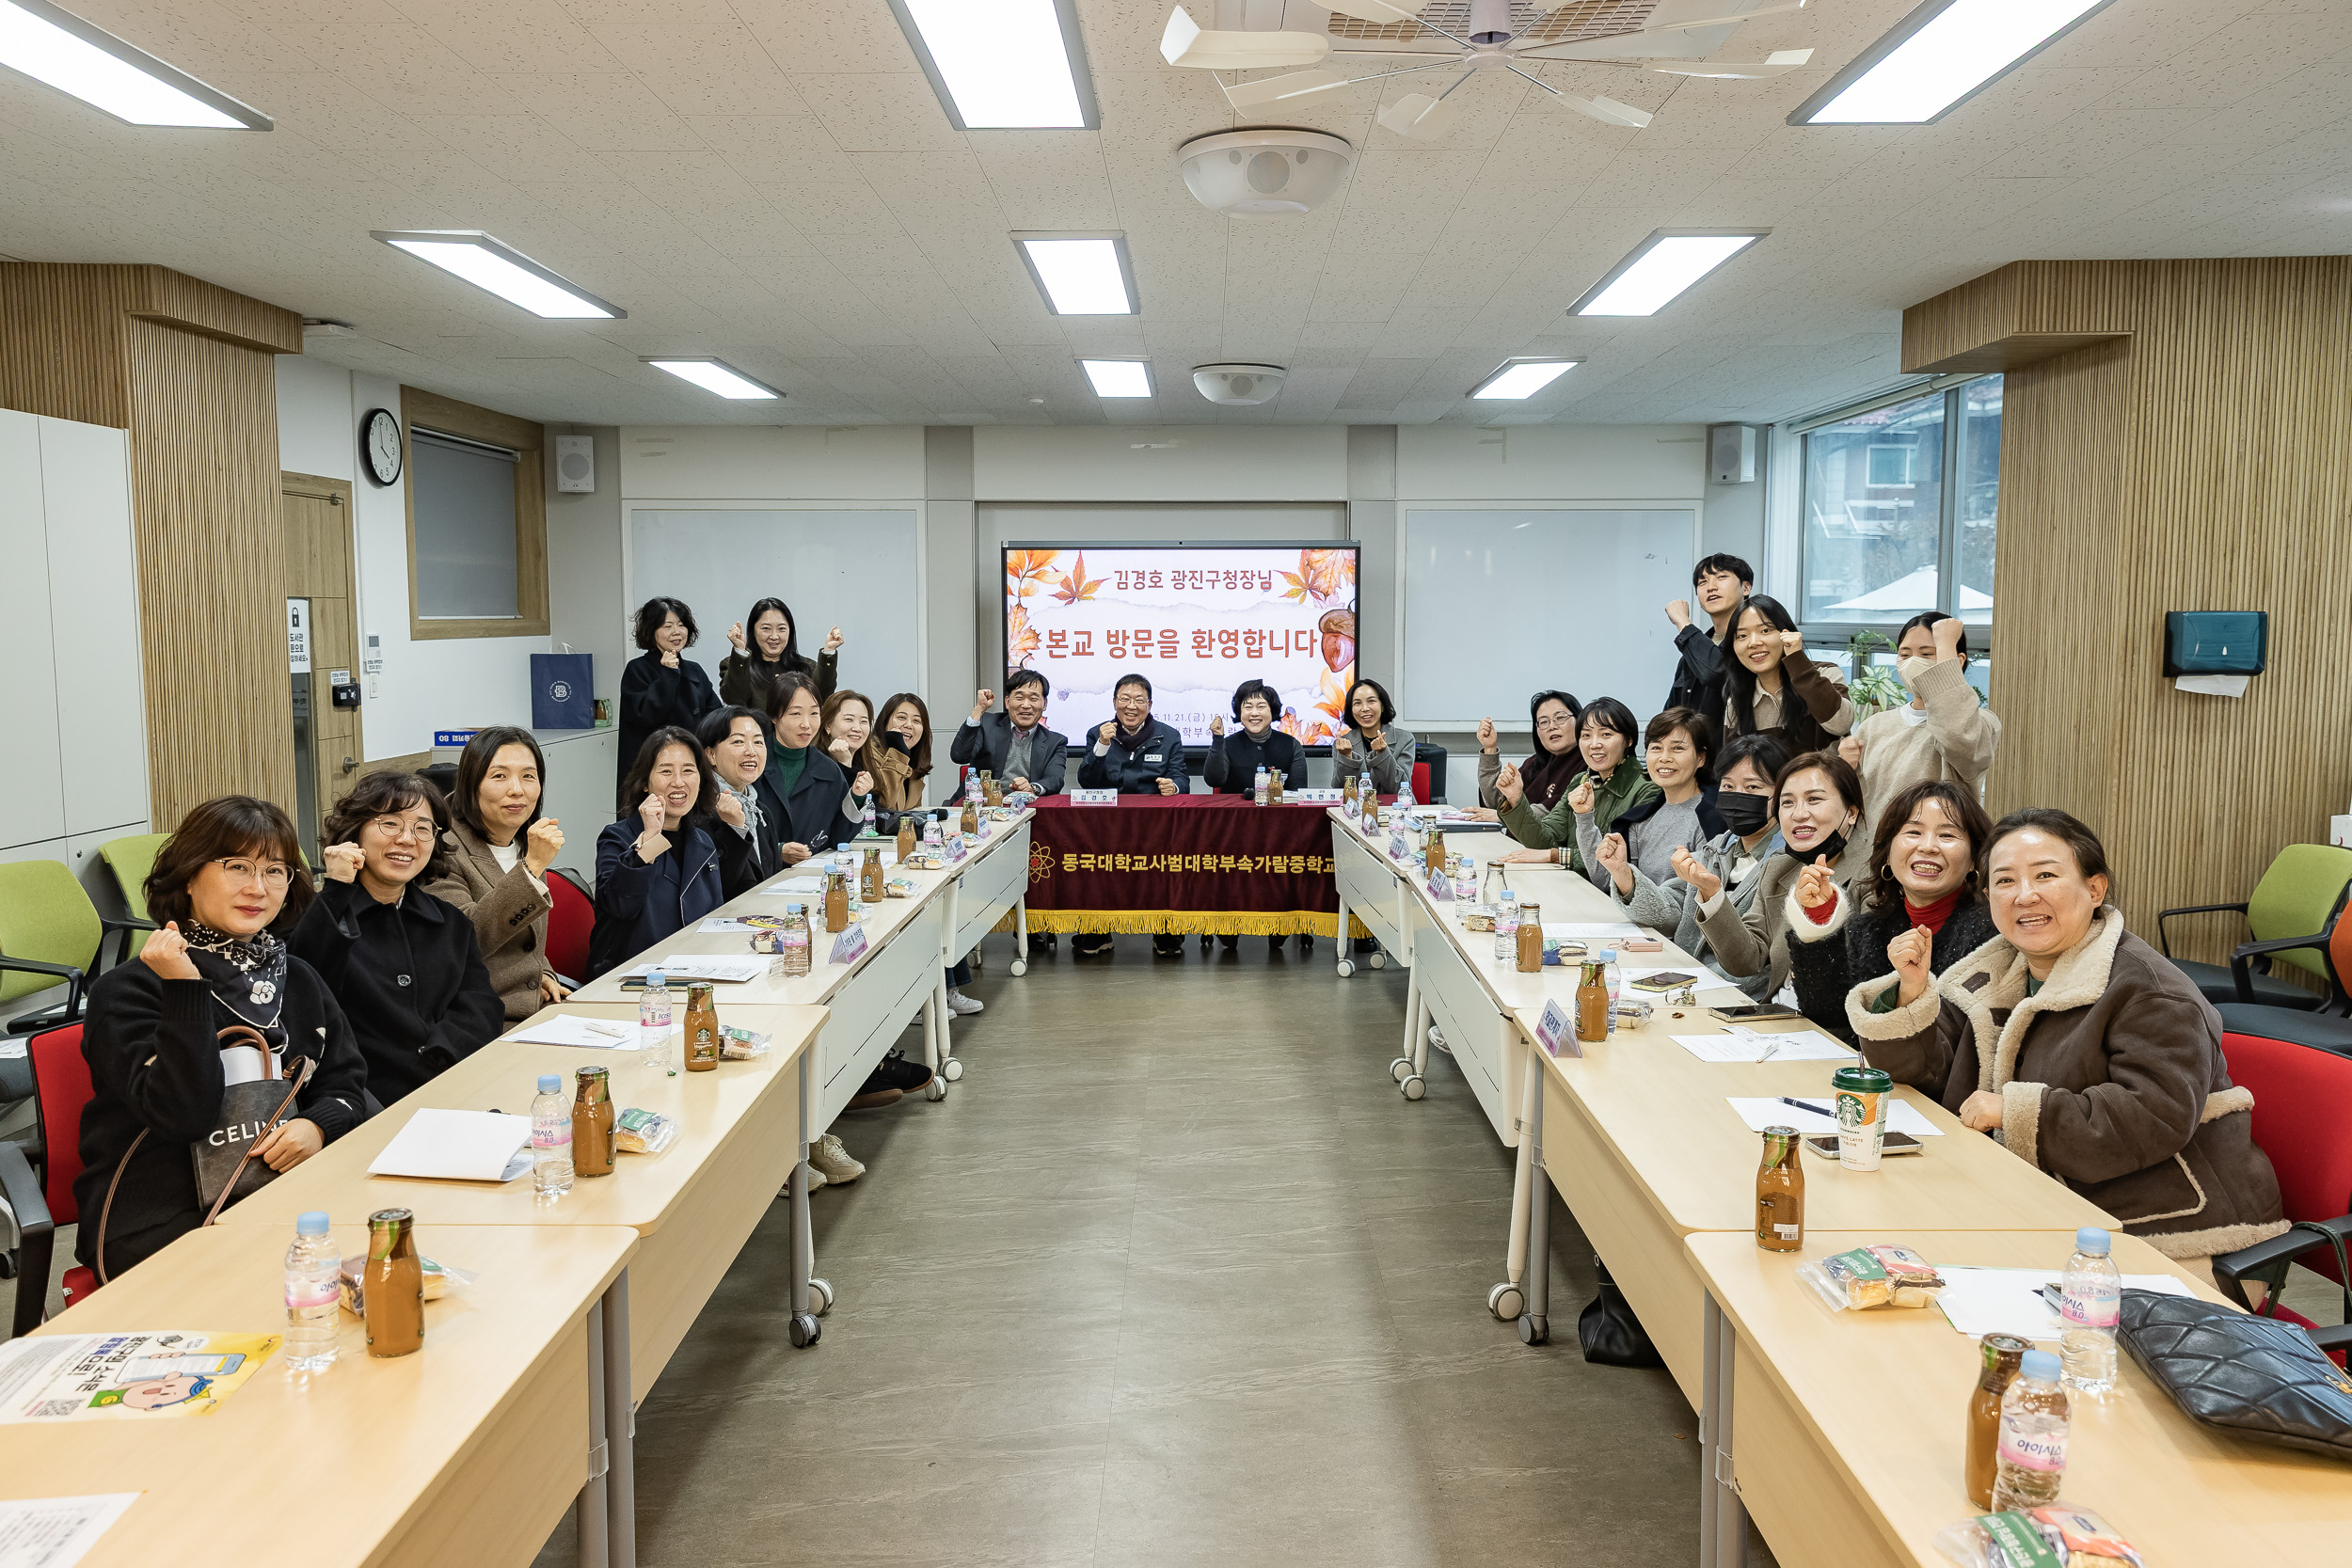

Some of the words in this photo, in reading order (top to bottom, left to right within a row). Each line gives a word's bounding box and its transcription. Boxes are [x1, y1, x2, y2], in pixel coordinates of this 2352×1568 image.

[1114, 570, 1164, 591] 김경호
[1170, 570, 1272, 591] 광진구청장님
[1045, 628, 1094, 658] 본교
[1106, 628, 1180, 658] 방문을
[1191, 628, 1317, 658] 환영합니다
[1062, 853, 1335, 874] 동국대학교사범대학부속가람중학교
[2072, 1309, 2085, 1319] 8.0
[104, 1336, 152, 1363] 광진구의
[75, 1365, 116, 1392] 소식은
